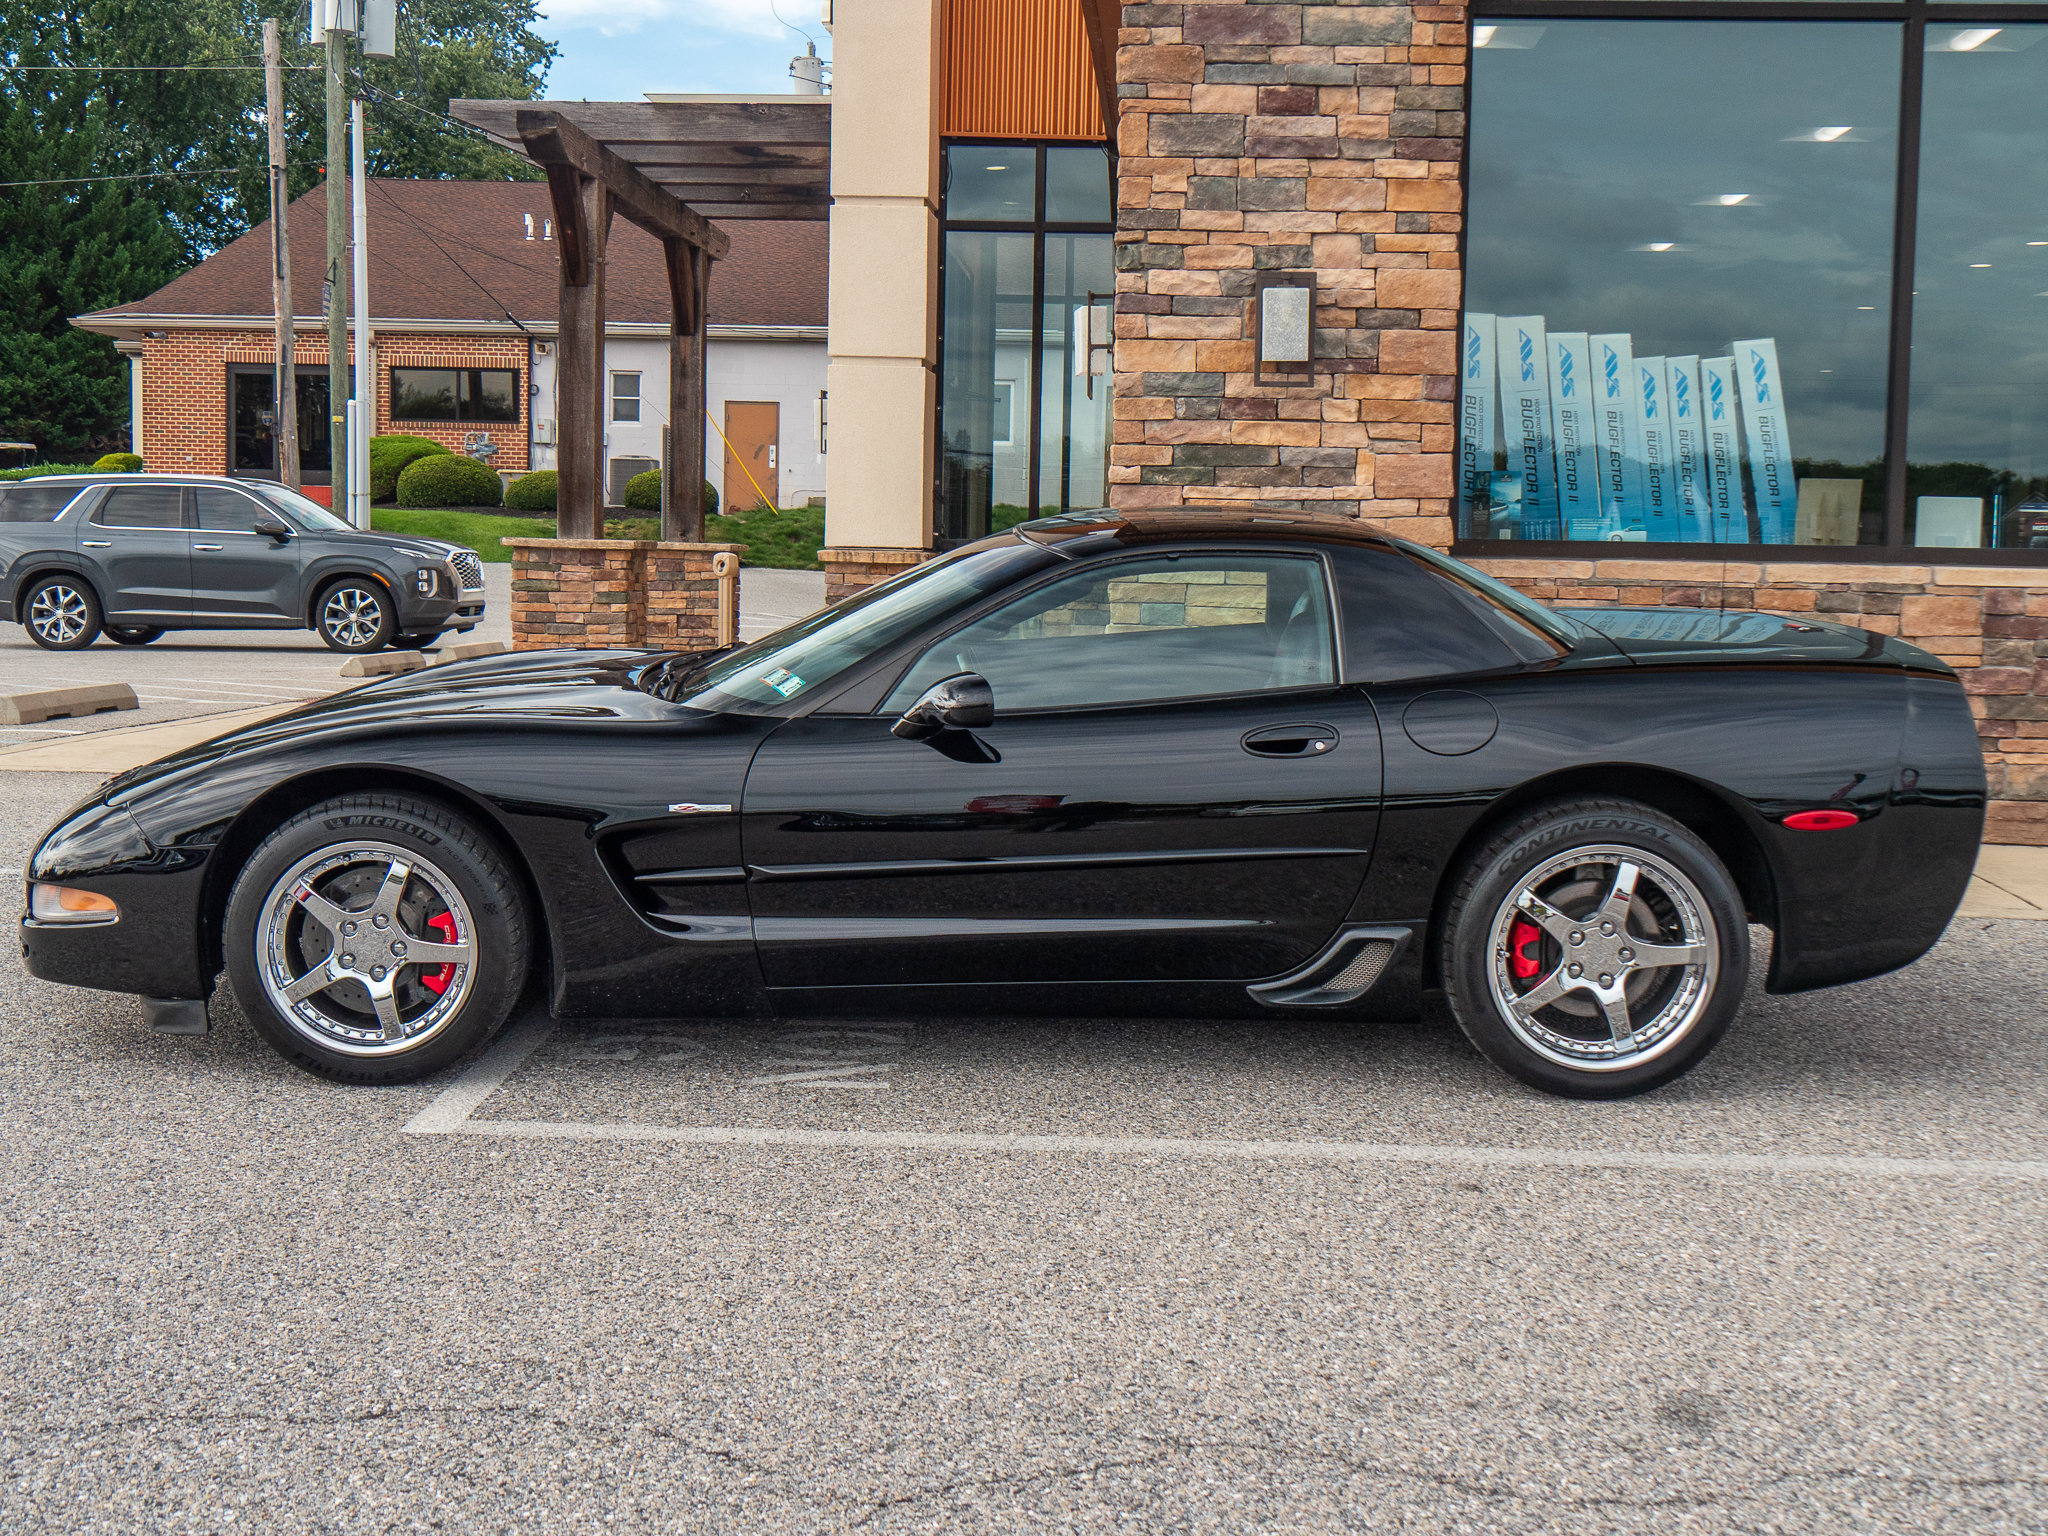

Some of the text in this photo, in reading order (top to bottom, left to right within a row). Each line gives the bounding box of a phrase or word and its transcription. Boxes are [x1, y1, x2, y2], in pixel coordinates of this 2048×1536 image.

[1468, 326, 1480, 379] AVS
[1519, 328, 1534, 382] AVS
[1559, 343, 1575, 398] AVS
[1604, 343, 1620, 398] AVS
[1750, 349, 1770, 403] AVS
[1642, 367, 1658, 419] AVS
[1674, 367, 1690, 418] AVS
[1708, 368, 1725, 421] AVS
[1464, 395, 1477, 492] BUGFLECTOR
[1520, 398, 1538, 492] BUGFLECTOR
[1535, 417, 1543, 452] PROTECTION
[1561, 410, 1578, 490] BUGFLECTOR
[1607, 410, 1624, 491] BUGFLECTOR
[1758, 415, 1779, 496] BUGFLECTOR
[1646, 430, 1662, 506] BUGFLECTOR
[1679, 429, 1695, 505] BUGFLECTOR
[1712, 432, 1729, 508] BUGFLECTOR
[348, 816, 437, 842] MICHELIN
[1498, 818, 1673, 876] CONTINENTAL
